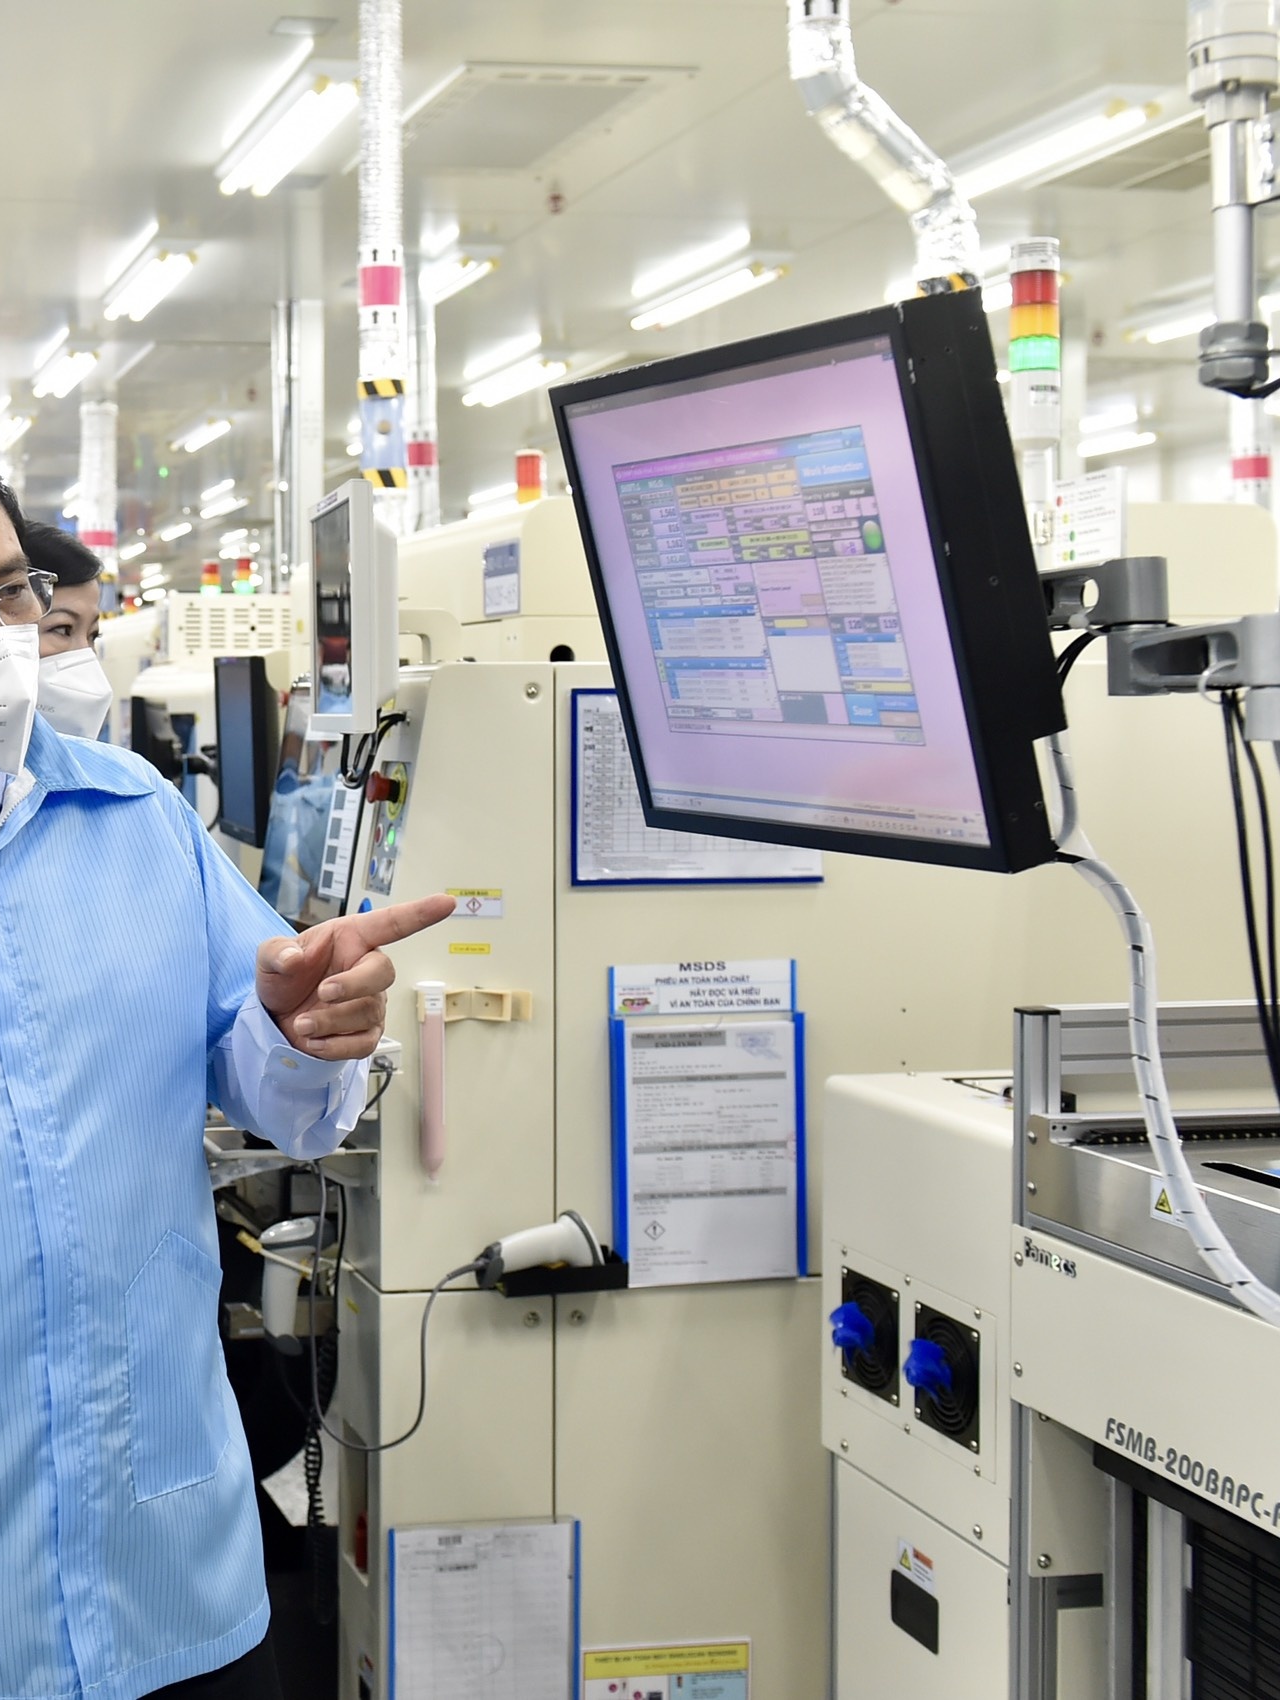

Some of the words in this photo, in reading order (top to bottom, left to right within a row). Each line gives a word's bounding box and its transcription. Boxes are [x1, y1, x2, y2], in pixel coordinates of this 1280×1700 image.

[679, 961, 726, 972] MSDS
[691, 976, 711, 984] TOÀN
[680, 1000, 691, 1008] AN
[693, 998, 717, 1008] TOÀN
[1024, 1236, 1077, 1278] Famecs
